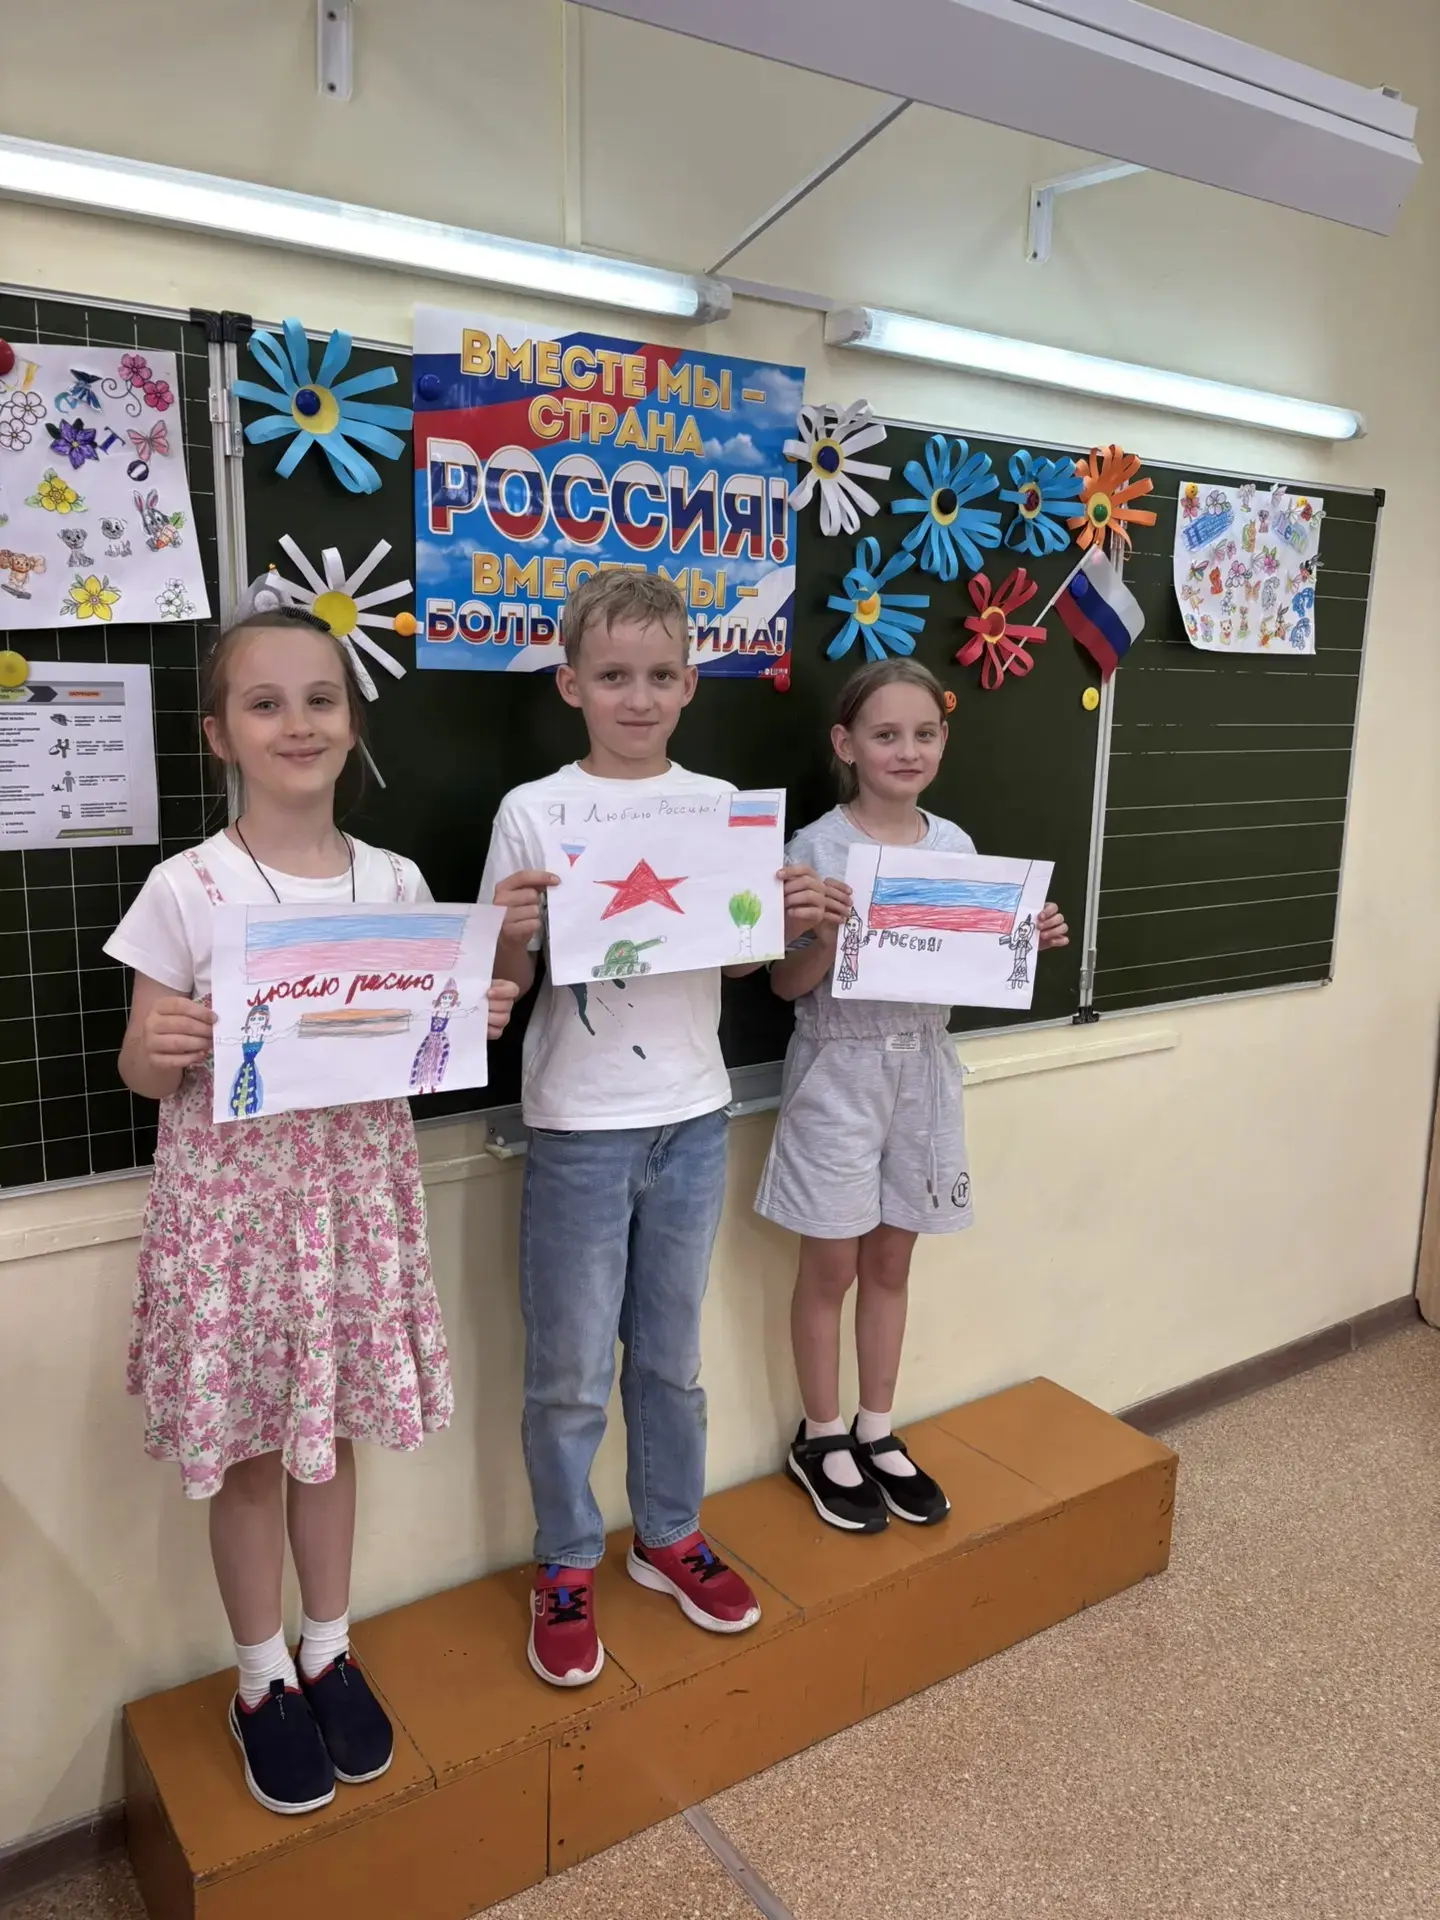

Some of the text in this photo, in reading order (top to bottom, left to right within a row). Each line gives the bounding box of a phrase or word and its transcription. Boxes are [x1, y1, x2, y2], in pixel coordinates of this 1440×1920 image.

[461, 328, 647, 399] ВМЕСТЕ
[657, 359, 732, 411] МЫ
[528, 395, 704, 457] СТРАНА
[427, 437, 789, 563] РОССИЯ!
[472, 552, 647, 604] ВМЕС
[688, 612, 787, 656] ИЛА!
[547, 794, 722, 826] Я Люблю Россию!
[878, 929, 943, 952] РОССИЯ!
